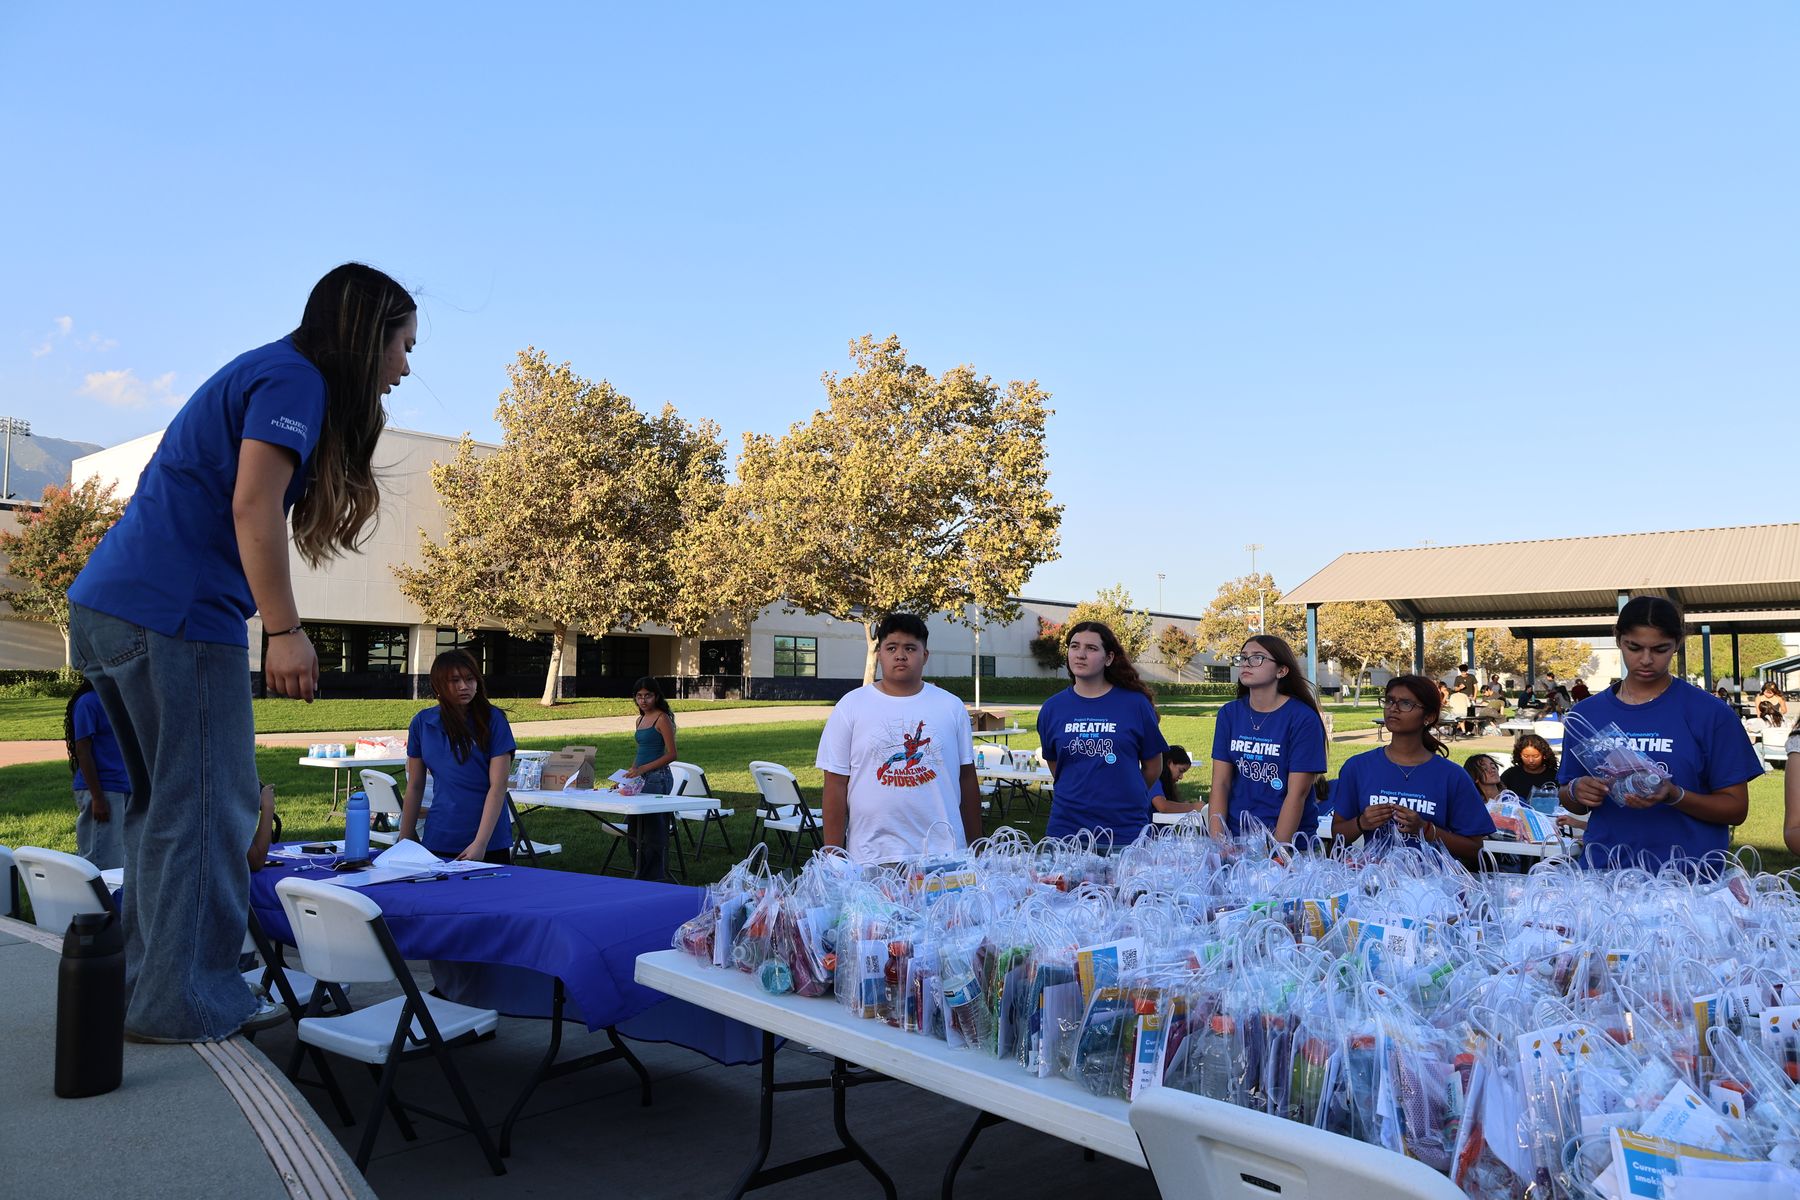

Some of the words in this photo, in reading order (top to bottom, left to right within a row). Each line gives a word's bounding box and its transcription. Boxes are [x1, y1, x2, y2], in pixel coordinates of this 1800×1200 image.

[1065, 722, 1117, 733] BREATHE
[1230, 739, 1280, 757] BREATHE
[894, 766, 927, 776] AMAZING
[881, 769, 937, 787] SPIDER-MAN
[1398, 791, 1426, 799] Pulmonary's
